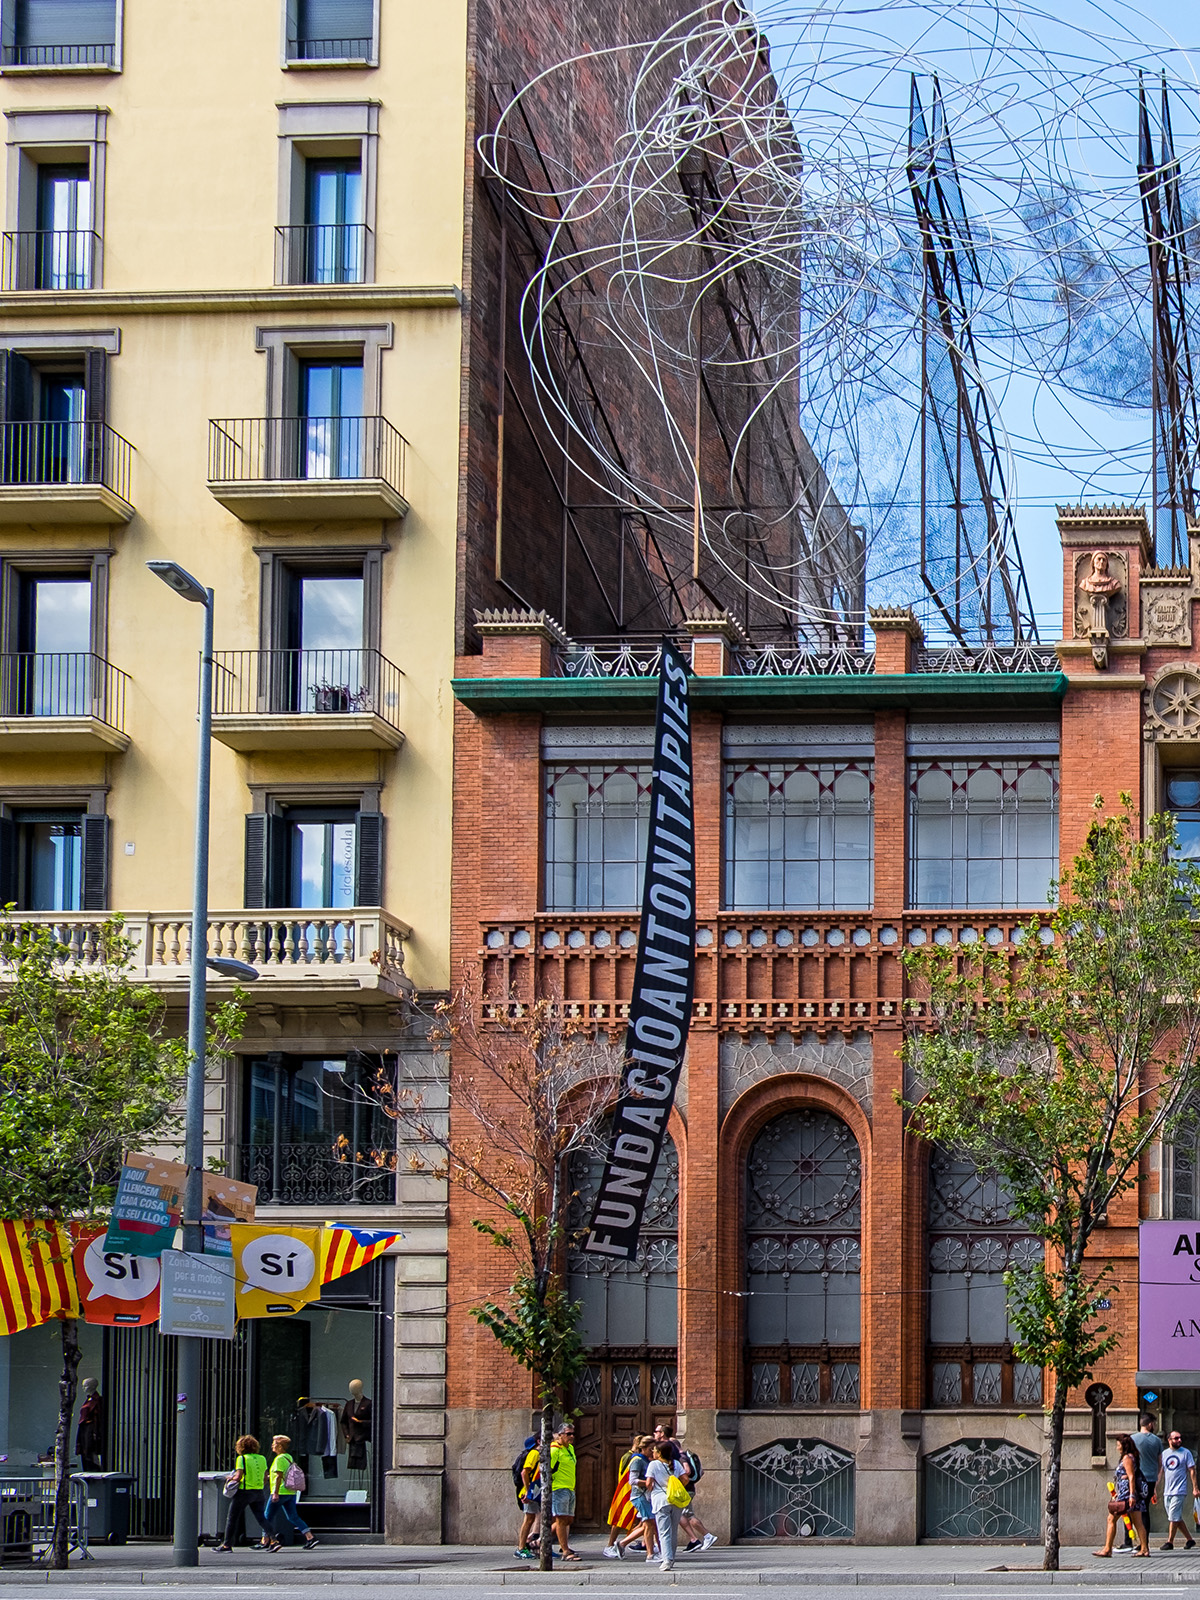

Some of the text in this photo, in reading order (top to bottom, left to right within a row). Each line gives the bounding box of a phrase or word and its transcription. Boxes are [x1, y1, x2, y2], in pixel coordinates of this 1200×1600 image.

[123, 1182, 159, 1197] LLENCEM
[120, 1195, 164, 1212] CADA COSA
[116, 1208, 168, 1225] AL SEU LLOC
[168, 1255, 190, 1268] Zona
[260, 1252, 298, 1278] Sí
[175, 1271, 223, 1285] per a motos
